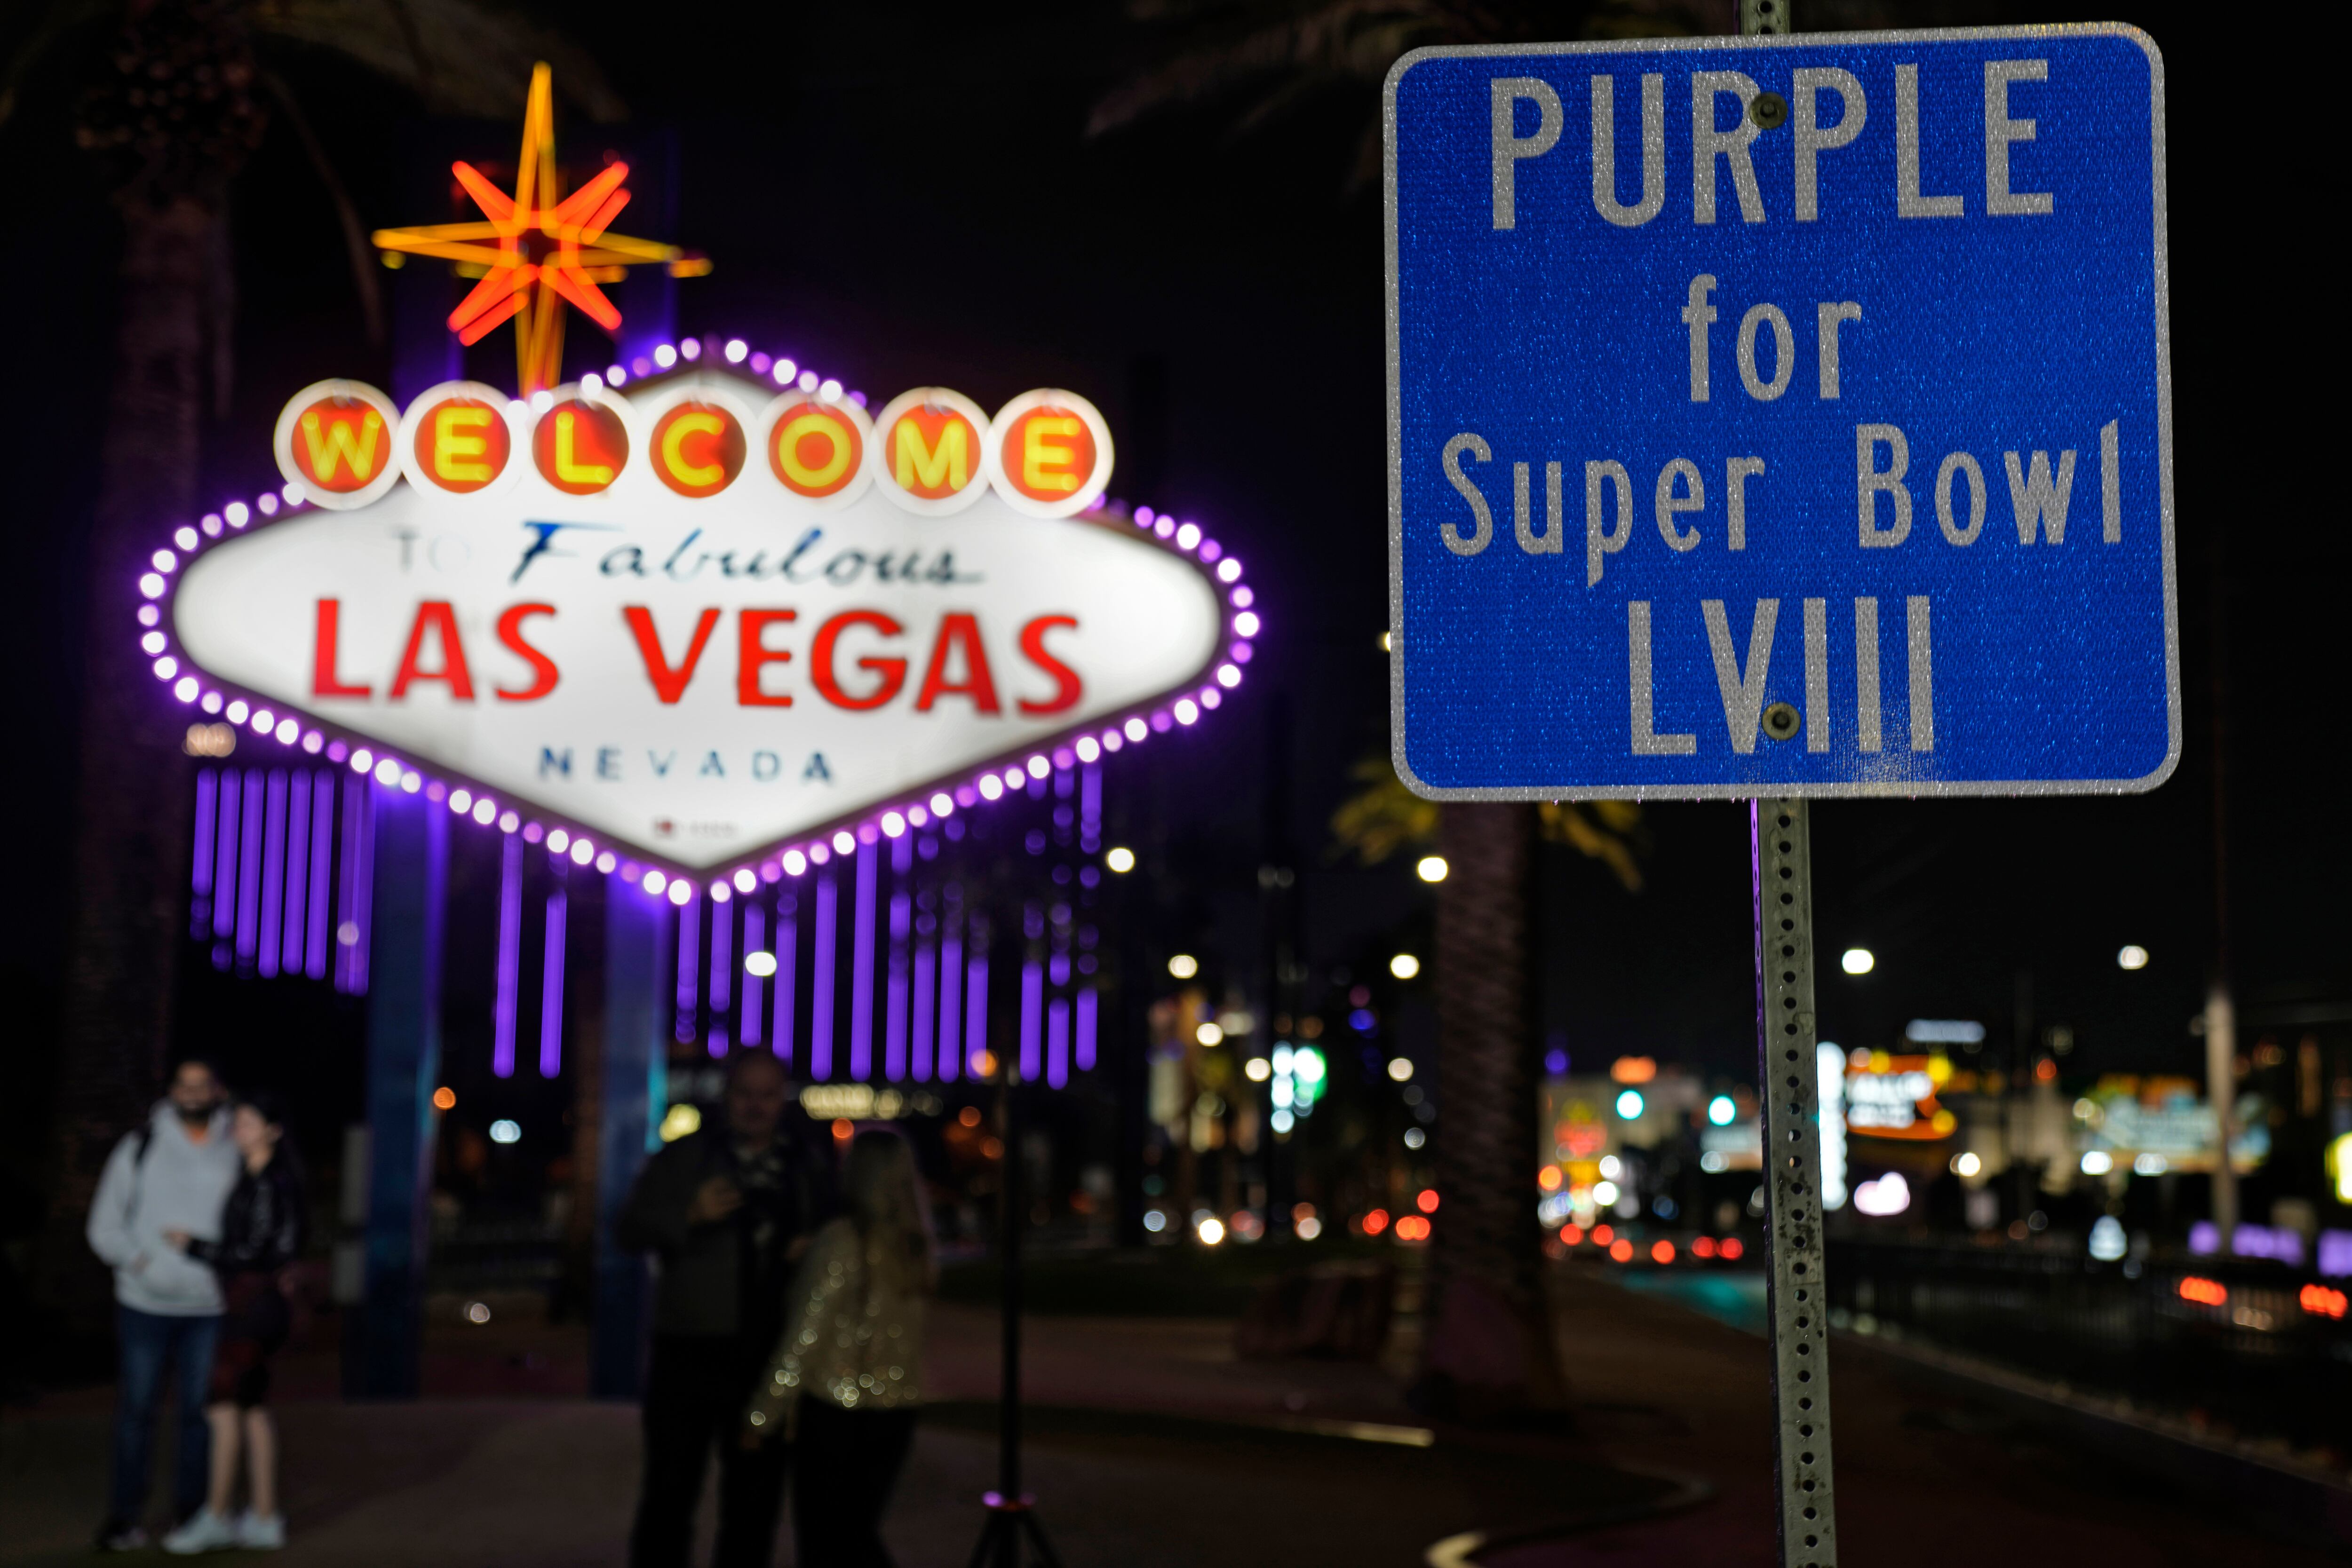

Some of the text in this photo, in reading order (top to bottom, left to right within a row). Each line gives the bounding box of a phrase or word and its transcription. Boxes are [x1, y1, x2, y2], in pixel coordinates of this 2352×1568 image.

[1490, 58, 2054, 230] PURPLE
[1681, 273, 1861, 402] for
[302, 407, 1081, 491] WELCOME
[1439, 419, 2120, 588] Super Bowl
[509, 519, 985, 586] Fabulous
[311, 598, 1085, 716] LAS VEGAS
[1629, 595, 1935, 756] LVIII
[539, 747, 836, 784] NEVADA
